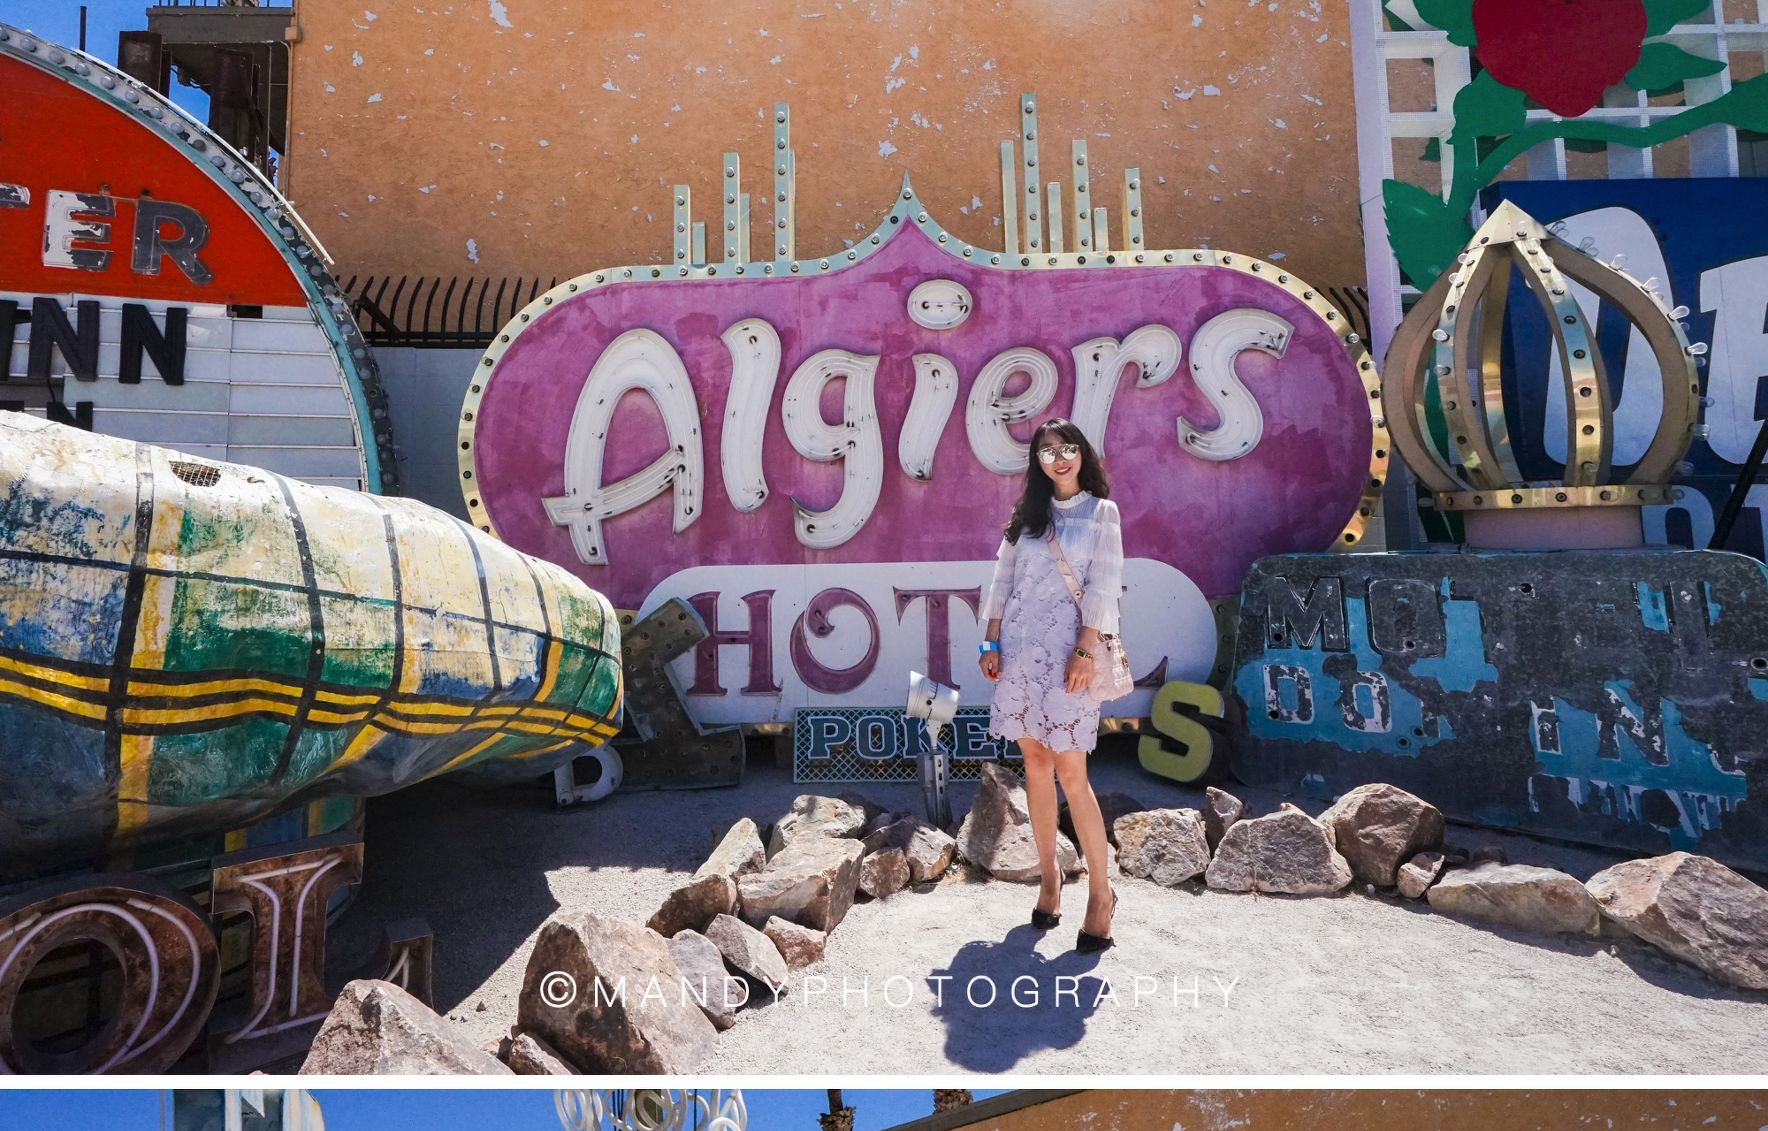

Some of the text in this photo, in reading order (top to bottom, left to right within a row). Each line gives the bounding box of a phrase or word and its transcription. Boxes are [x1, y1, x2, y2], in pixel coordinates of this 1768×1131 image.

[0, 182, 214, 285] ER
[540, 278, 1295, 566] Algiers
[1137, 680, 1225, 783] S
